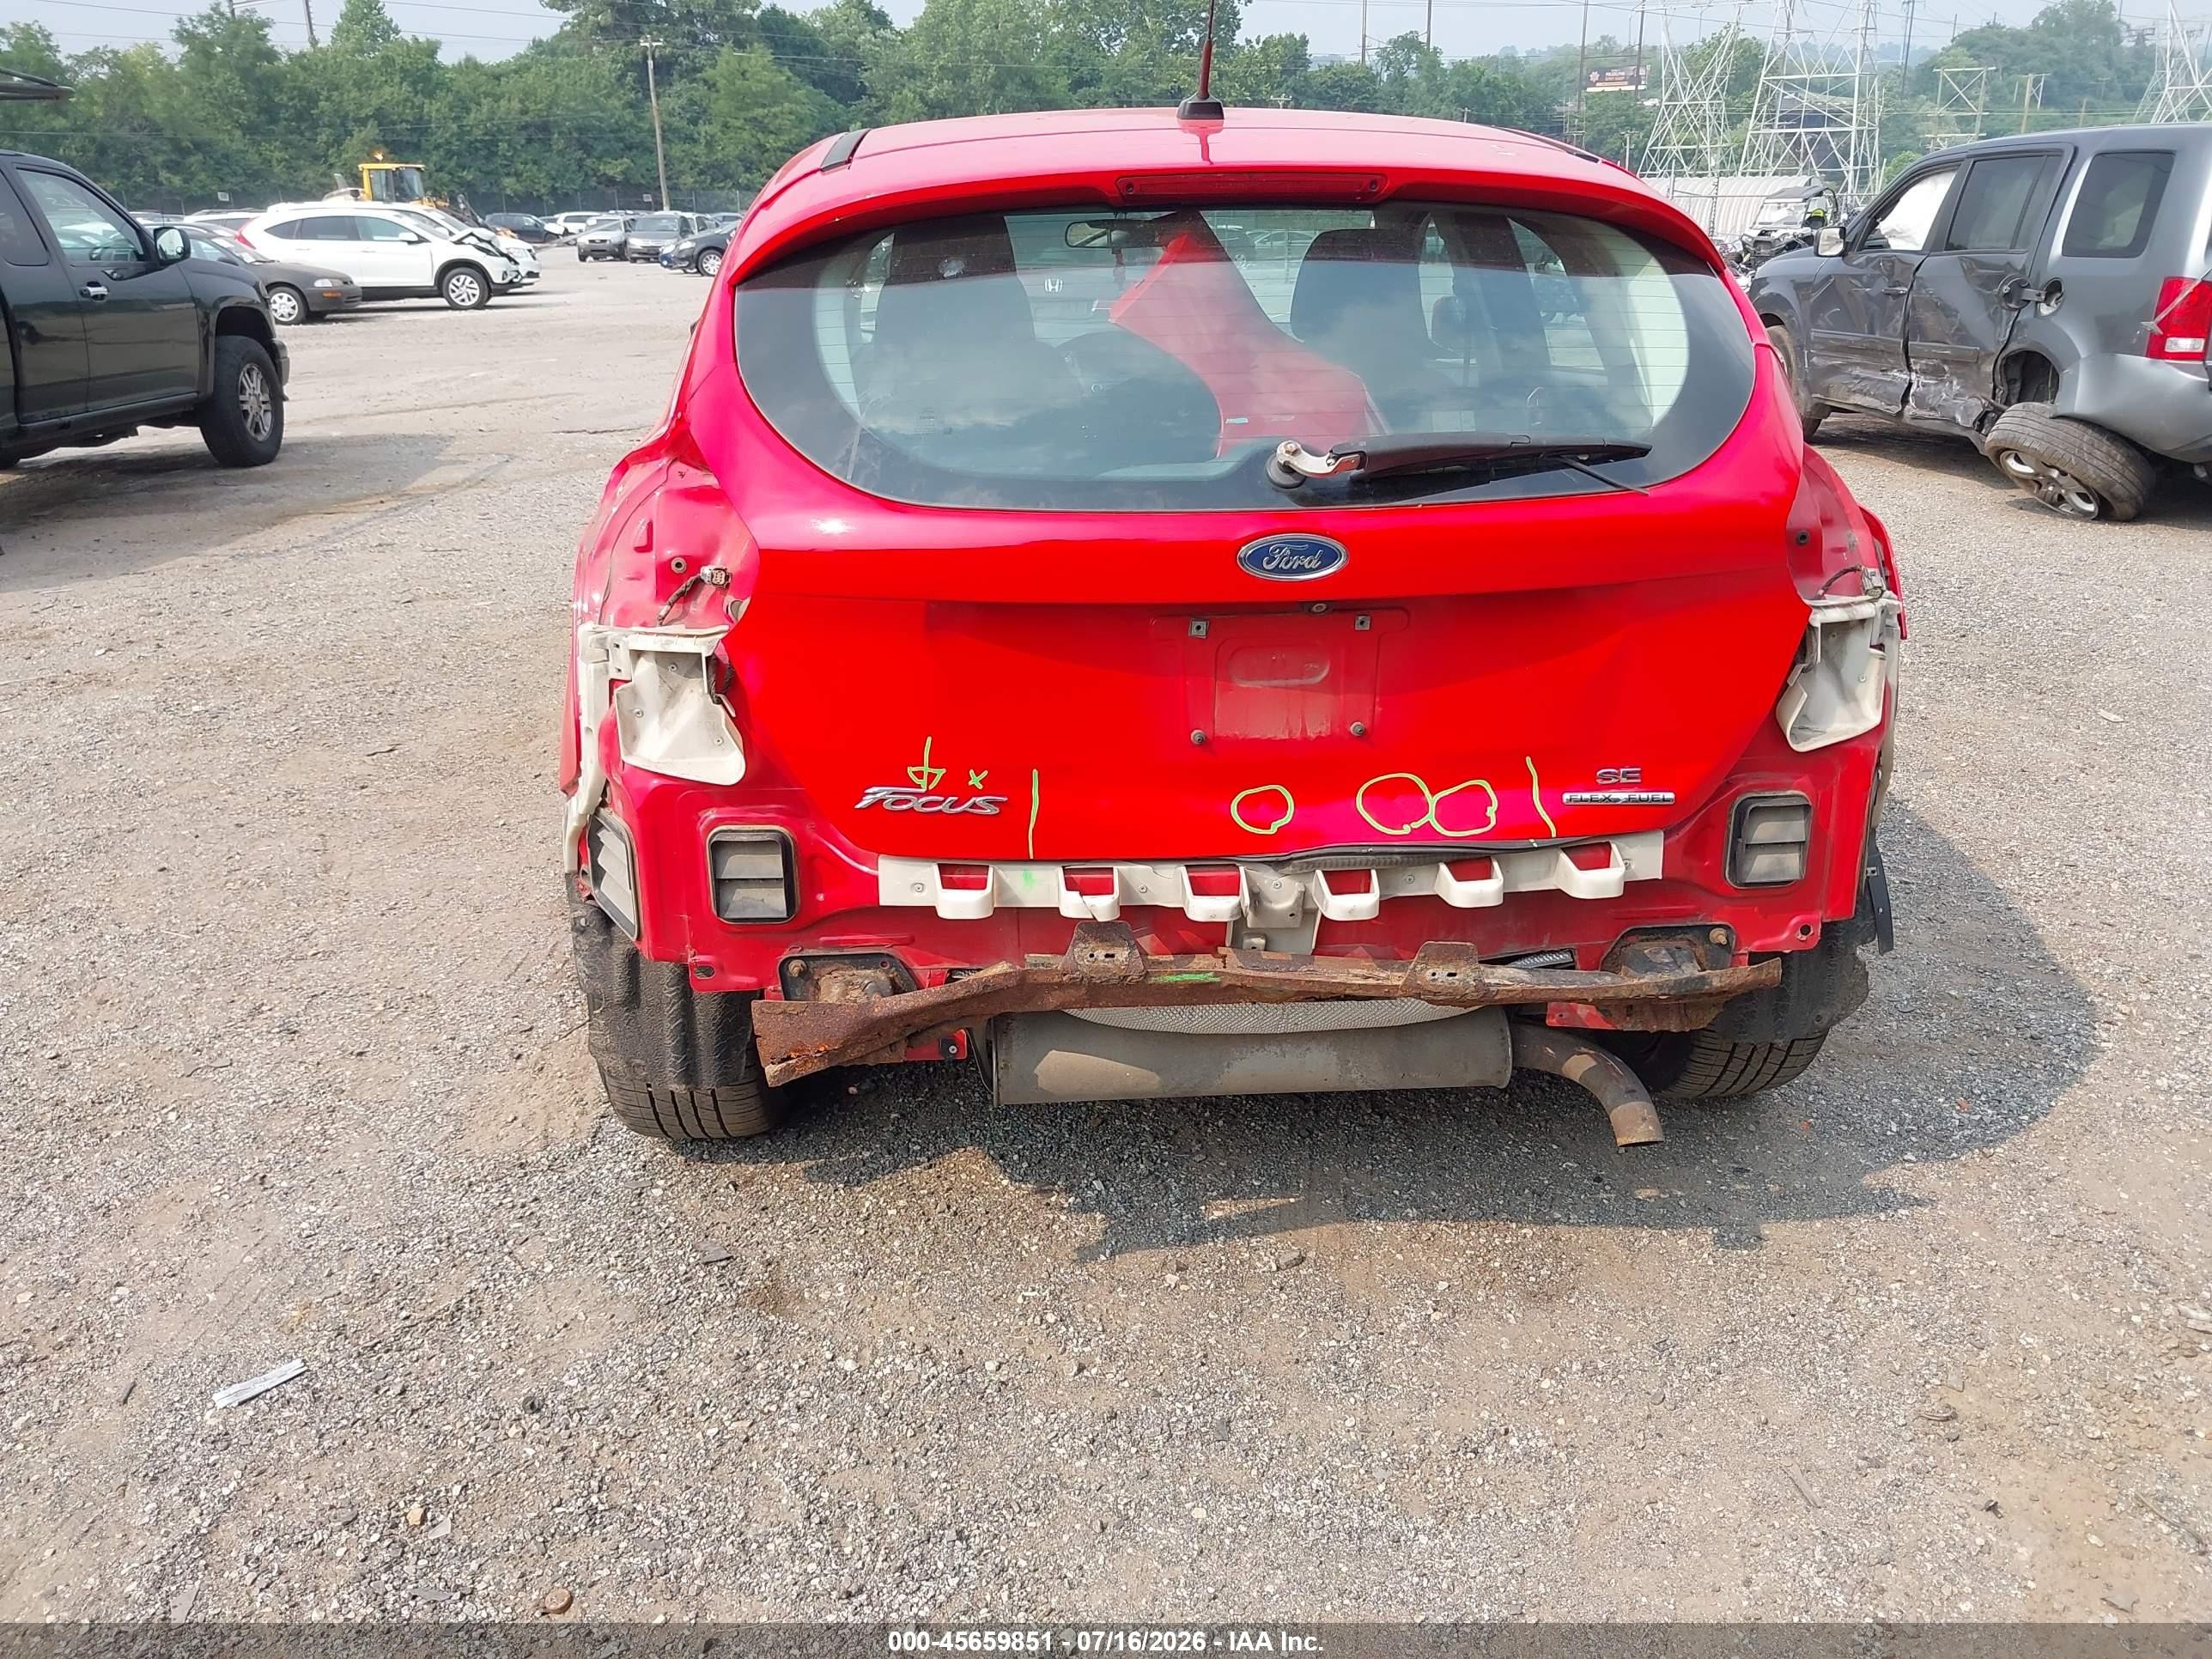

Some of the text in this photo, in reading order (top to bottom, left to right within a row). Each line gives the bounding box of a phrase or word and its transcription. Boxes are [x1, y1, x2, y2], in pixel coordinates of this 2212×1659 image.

[1262, 544, 1323, 570] Ford
[1595, 767, 1642, 784] SE
[1568, 793, 1671, 803] FLEX FUEL
